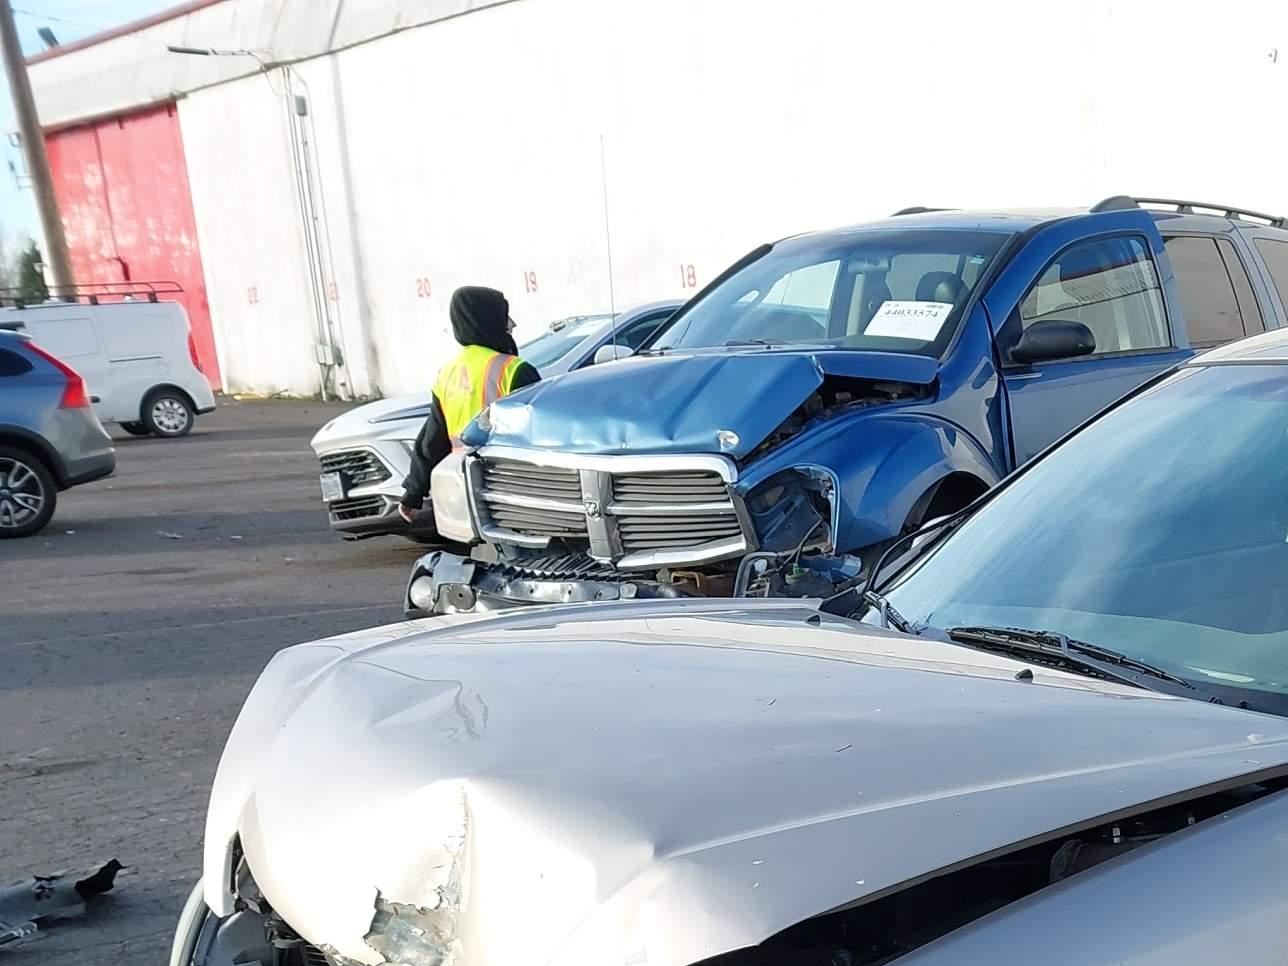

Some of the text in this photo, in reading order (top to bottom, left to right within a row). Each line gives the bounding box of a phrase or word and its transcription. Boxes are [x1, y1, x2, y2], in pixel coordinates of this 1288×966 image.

[416, 277, 431, 298] 20
[524, 271, 538, 293] 19
[680, 264, 697, 289] 18
